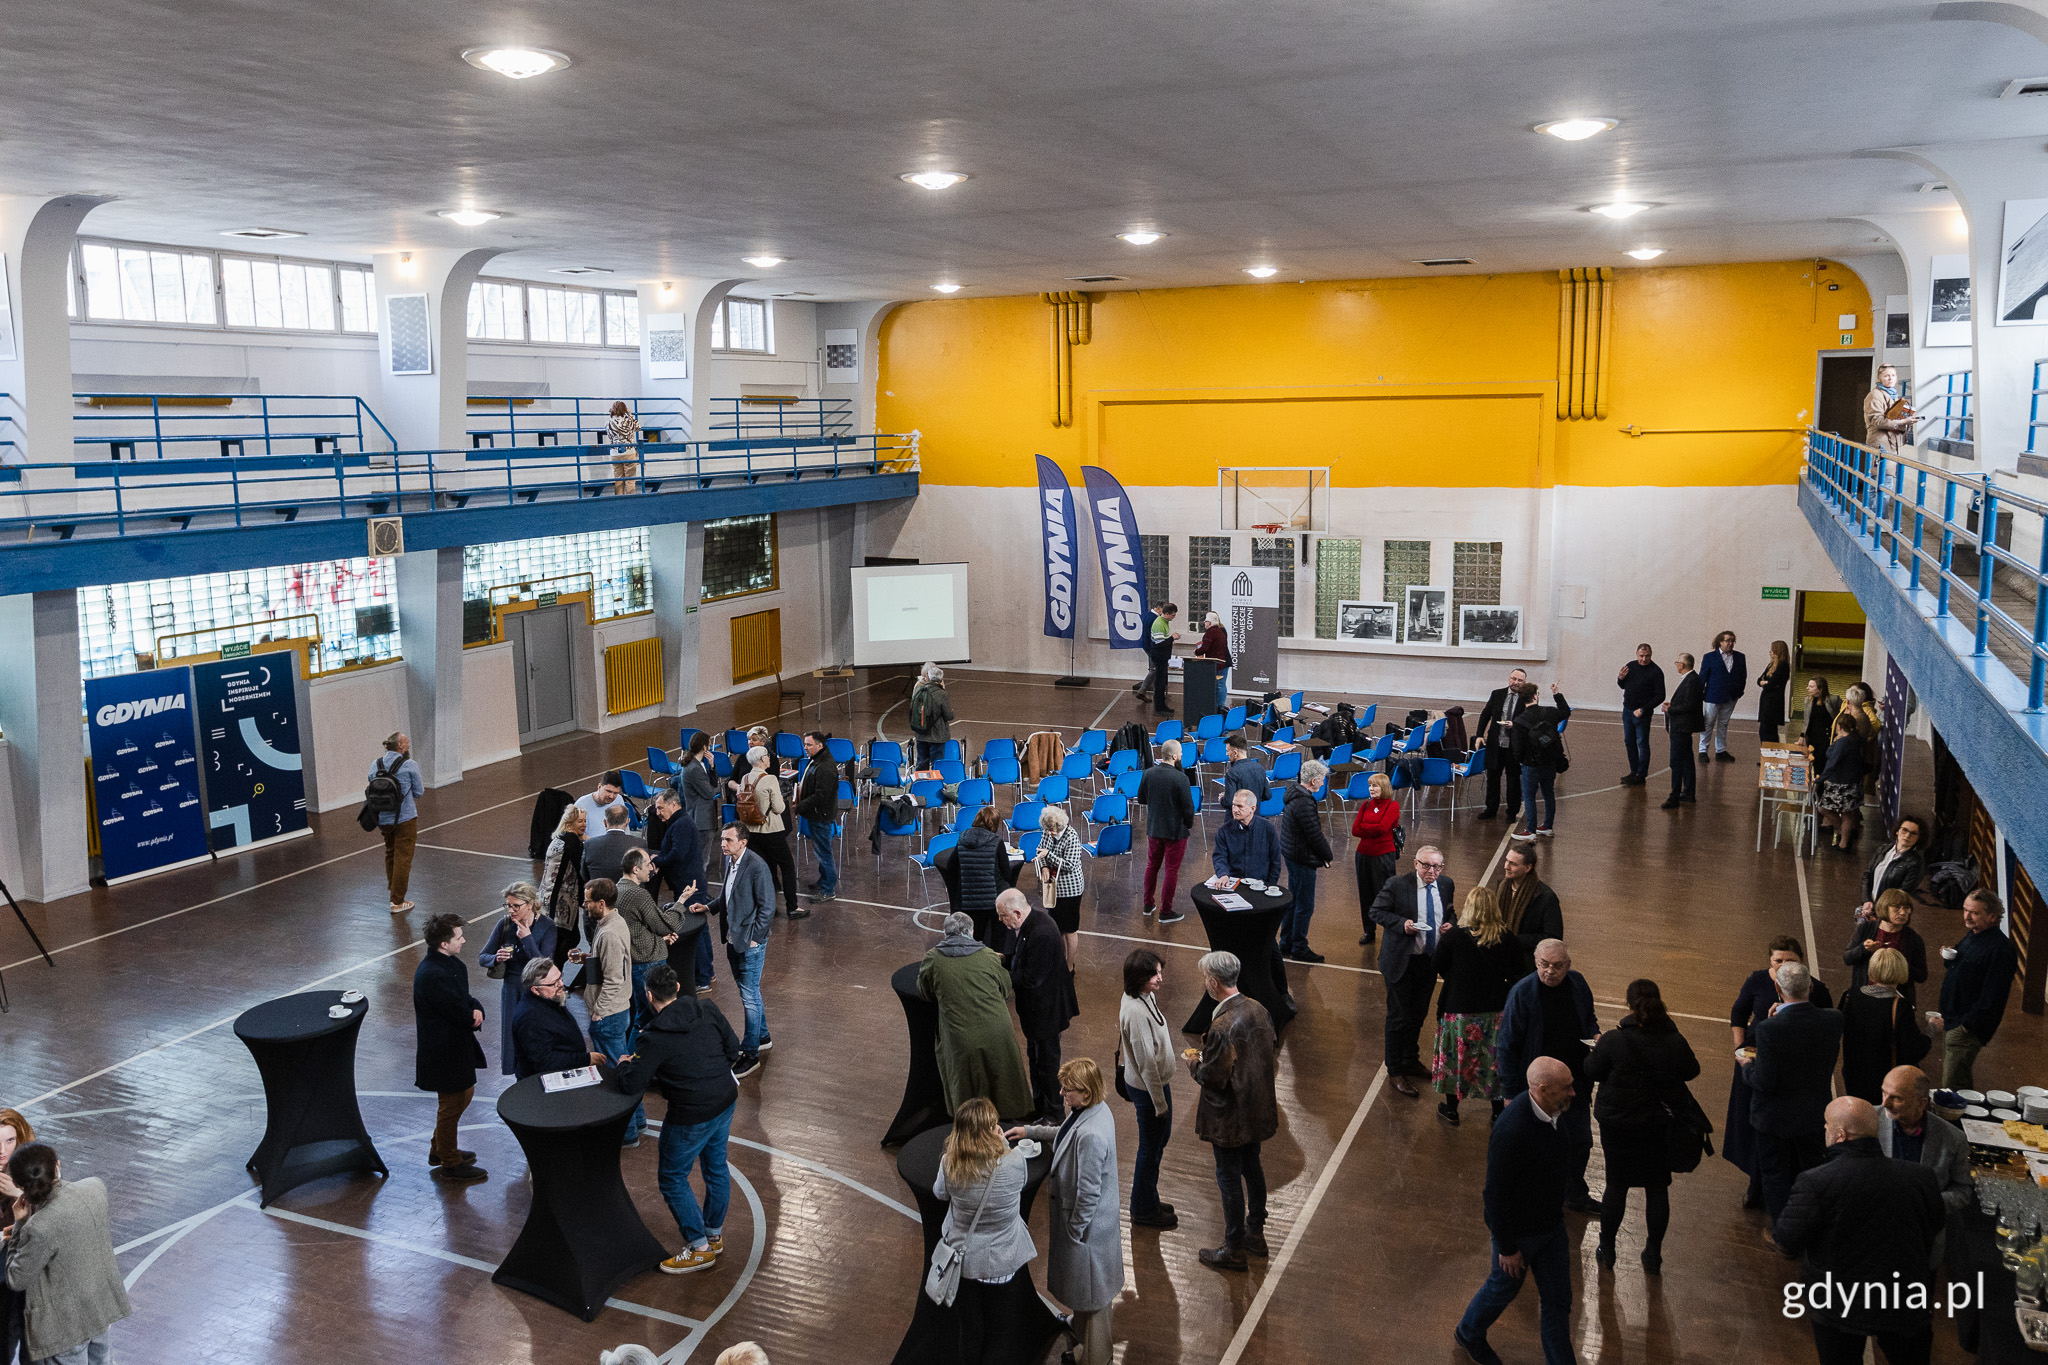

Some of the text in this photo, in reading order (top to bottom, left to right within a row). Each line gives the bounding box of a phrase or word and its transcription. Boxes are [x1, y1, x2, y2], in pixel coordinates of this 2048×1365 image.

[1045, 488, 1072, 631] GDYNIA
[1096, 496, 1143, 641] GDYNIA
[224, 644, 249, 653] WYJŚCIE
[1231, 606, 1239, 671] MODERNISTYCZNE
[227, 679, 250, 687] GDYNIA
[228, 685, 259, 695] INSPIRUJE
[228, 691, 271, 703] MODERNIZMEM
[96, 693, 186, 727] GDYNIA
